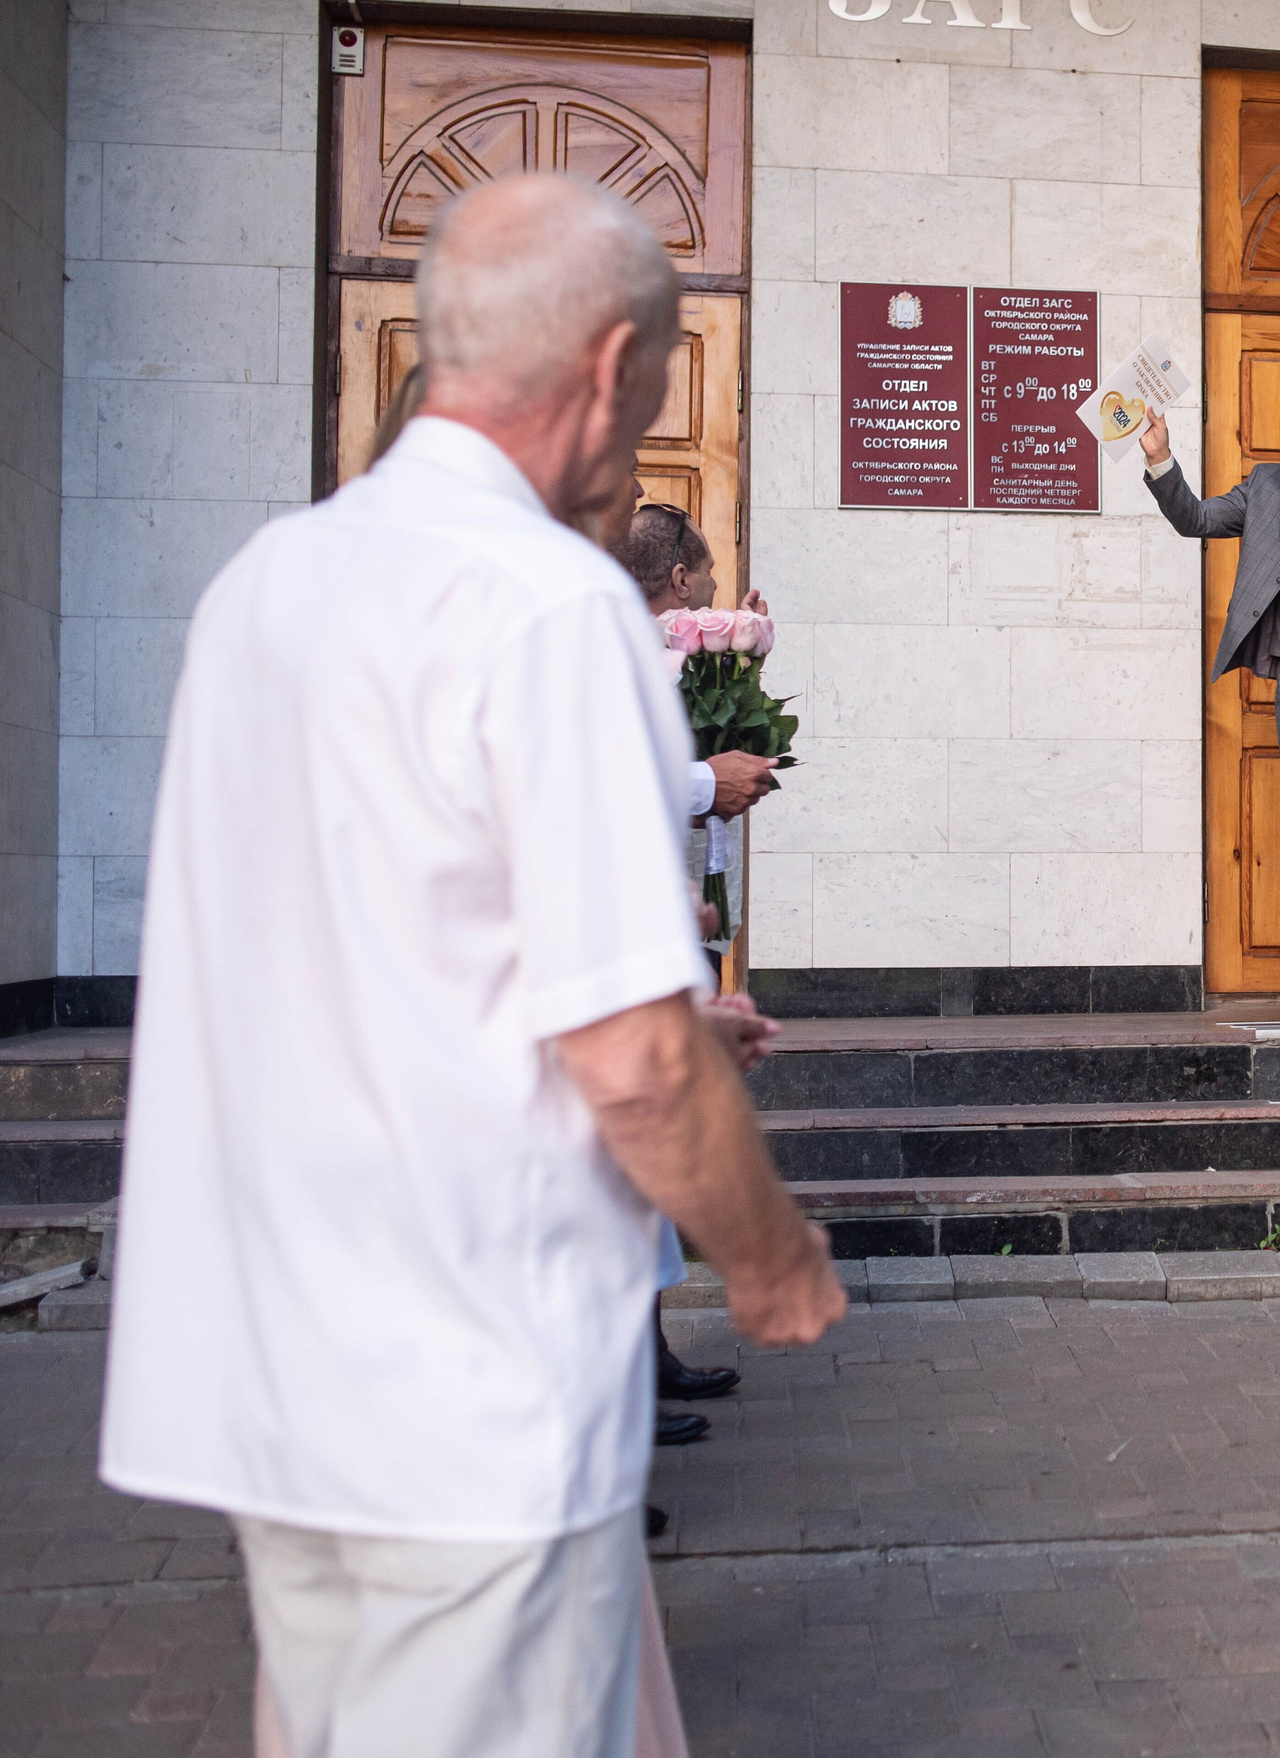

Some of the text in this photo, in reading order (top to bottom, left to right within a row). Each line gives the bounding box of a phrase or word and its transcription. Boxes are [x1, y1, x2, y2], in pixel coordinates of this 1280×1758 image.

[1001, 297, 1072, 309] ОТДЕЛ ЗАГС
[985, 311, 1088, 321] ОКТЯБРЬСКОГО РАЙОНА
[991, 322, 1081, 331] ГОРОДСКОГО ОКРУГА
[1019, 333, 1054, 341] САМАРА
[989, 345, 1084, 356] РЕЖИМ РАБОТЫ
[857, 353, 910, 361] ГРАЖДАНСКОГО
[982, 361, 996, 370] ВТ
[981, 374, 997, 383] СР
[1138, 354, 1171, 399] СВИДЕТЕЛЬСТВО
[882, 380, 928, 393] ОТДЕЛ
[982, 387, 996, 396] ЧТ
[1135, 381, 1148, 399] БРАКА
[1037, 387, 1056, 402] до
[853, 399, 958, 411] ЗАПИСИ АКТОВ
[982, 400, 996, 409] ПТ
[982, 413, 997, 422] СБ
[1113, 407, 1131, 428] 2024
[850, 418, 960, 431] ГРАЖДАНСКОГО
[1011, 425, 1056, 433] ПЕРЕРЫВ
[863, 438, 948, 449] СОСТОЯНИЯ
[1035, 443, 1049, 455] до
[852, 461, 958, 471] ОКТЯБРЬСКОГО РАЙОНА
[1012, 463, 1076, 472] ВЫХОДНЫЕ ДНИ
[860, 475, 951, 484] ГОРОДСКОГО ОКРУГА
[994, 478, 1078, 488] САНИТАРНЫЙ ДЕНЬ
[990, 487, 1082, 497] ПОСЛЕДНИЙ ЧЕТВЕРГ
[997, 497, 1075, 506] КАЖДОГО МЕСЯЦА
